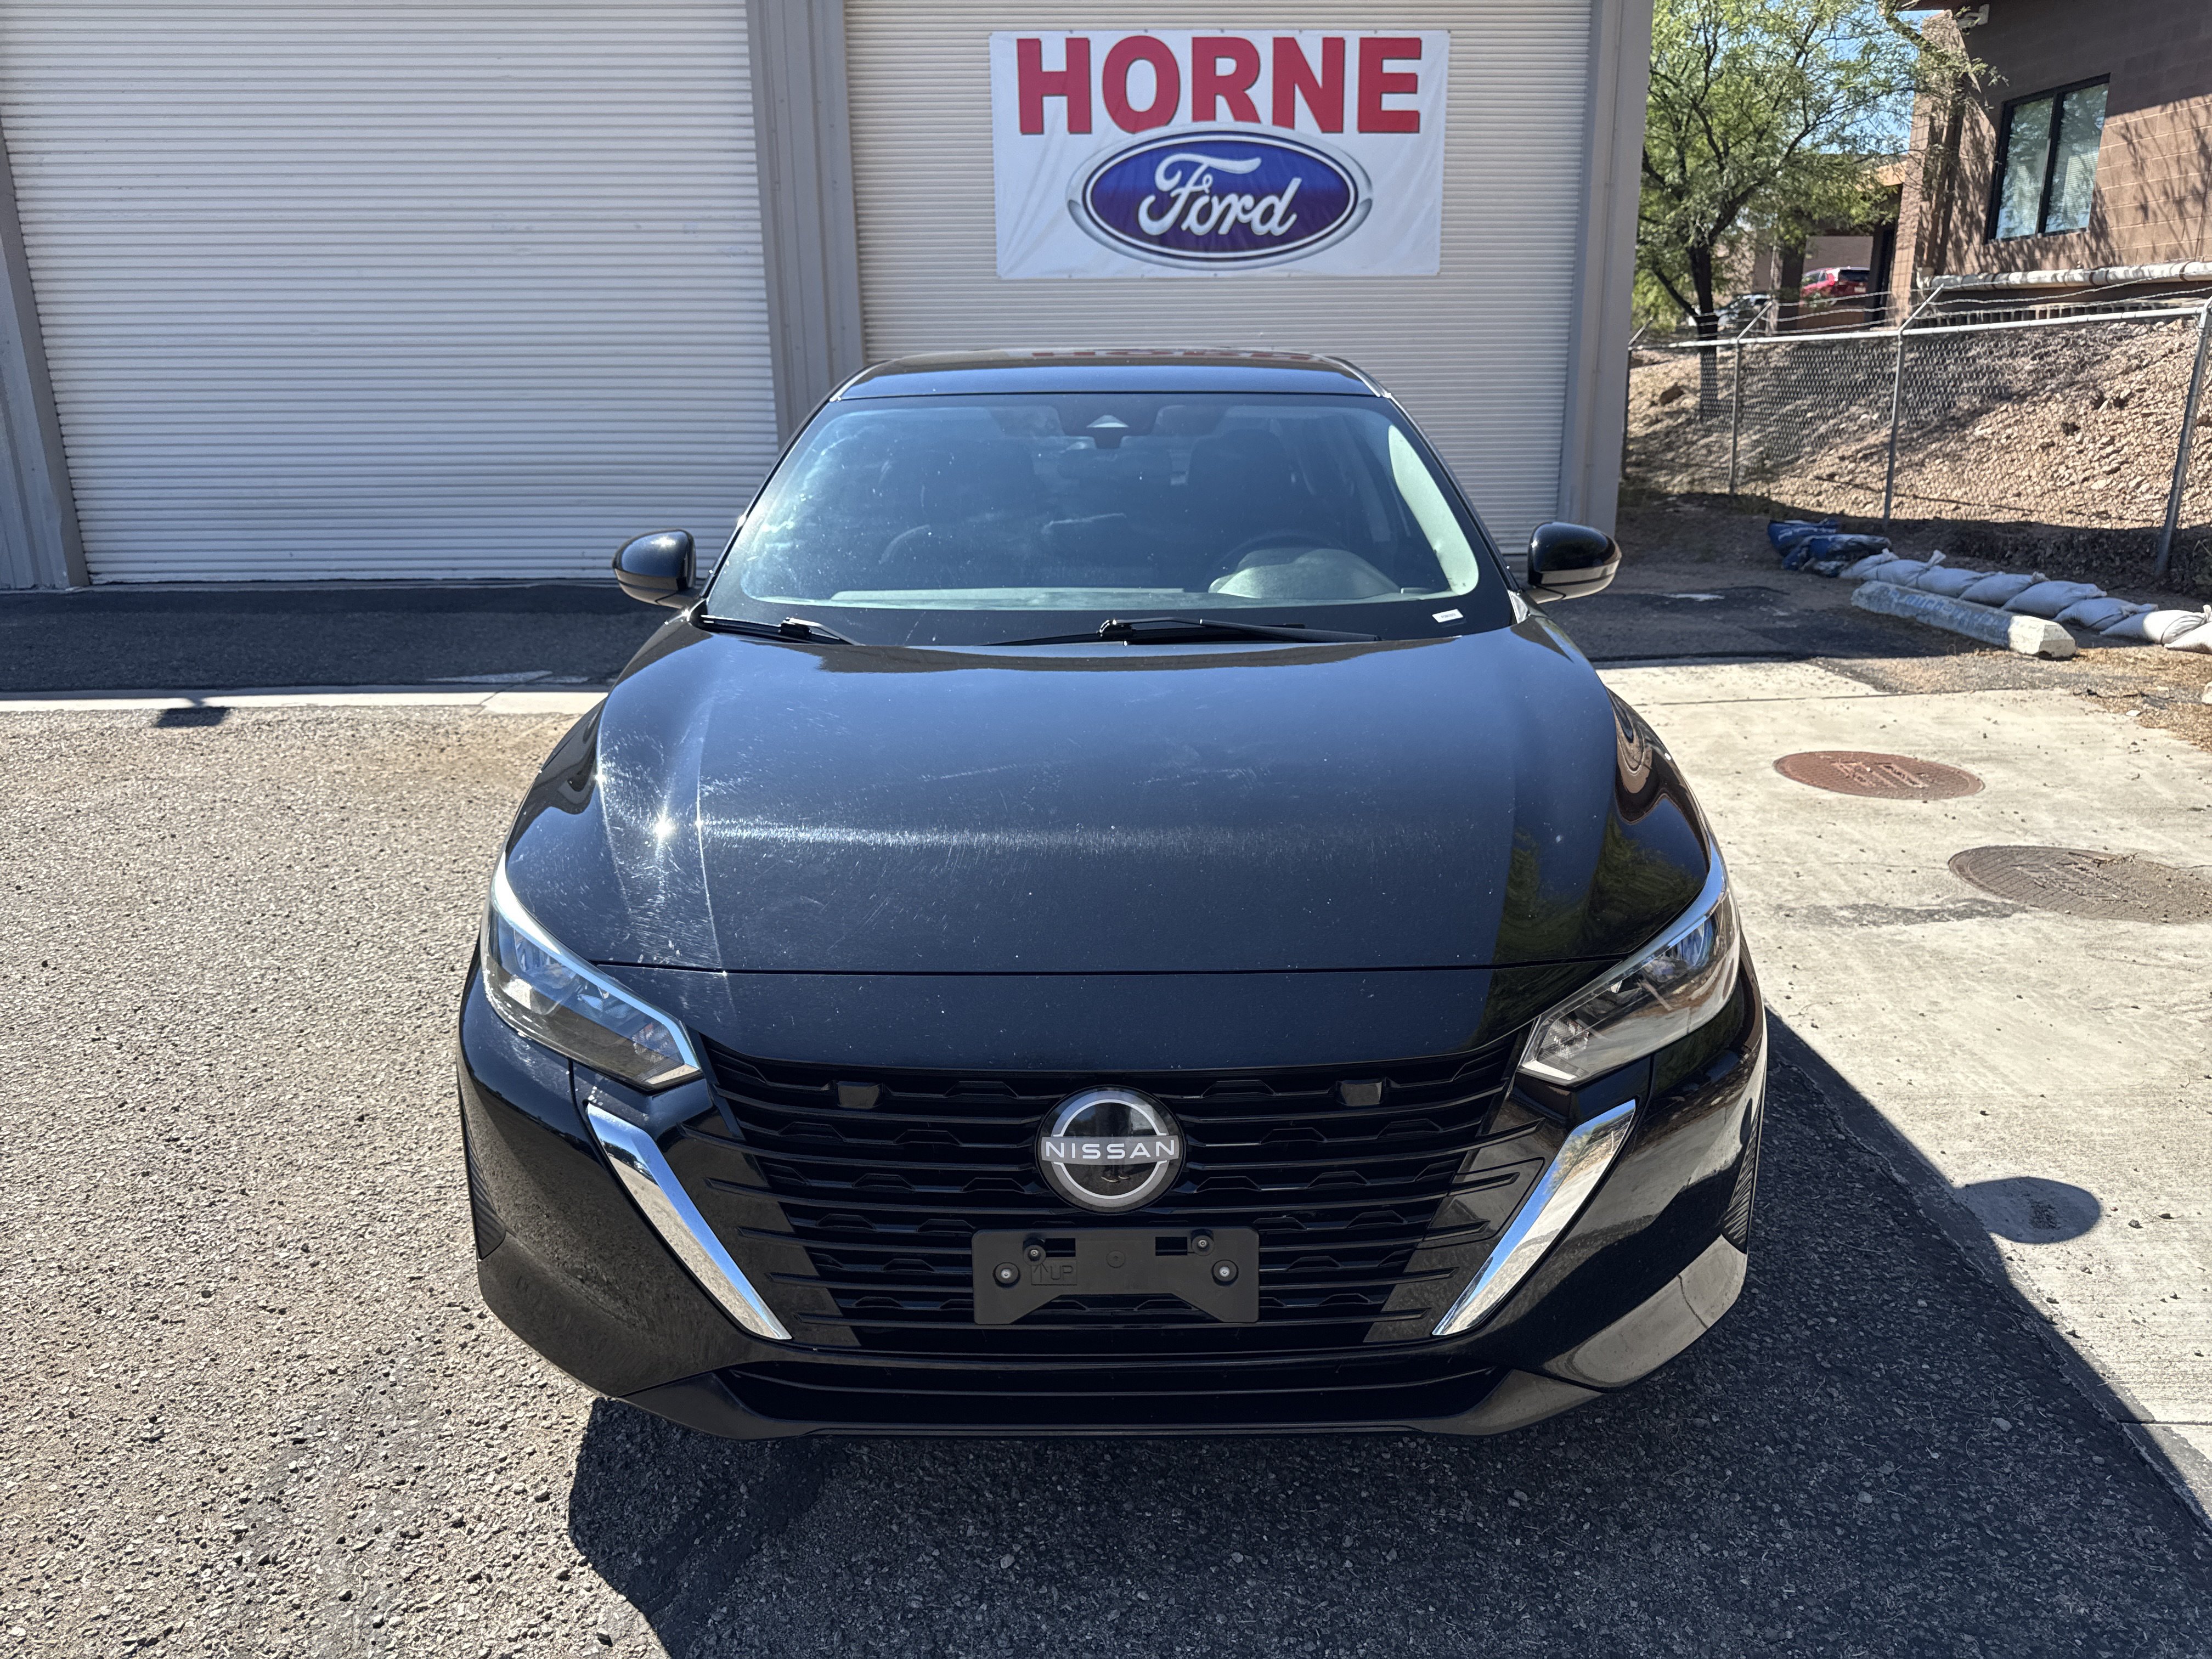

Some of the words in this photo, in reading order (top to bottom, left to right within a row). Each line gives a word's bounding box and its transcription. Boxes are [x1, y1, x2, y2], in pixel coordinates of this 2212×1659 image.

[1016, 35, 1423, 135] HORNE
[1138, 153, 1302, 236] Ford
[1045, 1140, 1175, 1159] NISSAN
[1050, 1265, 1073, 1280] UP
